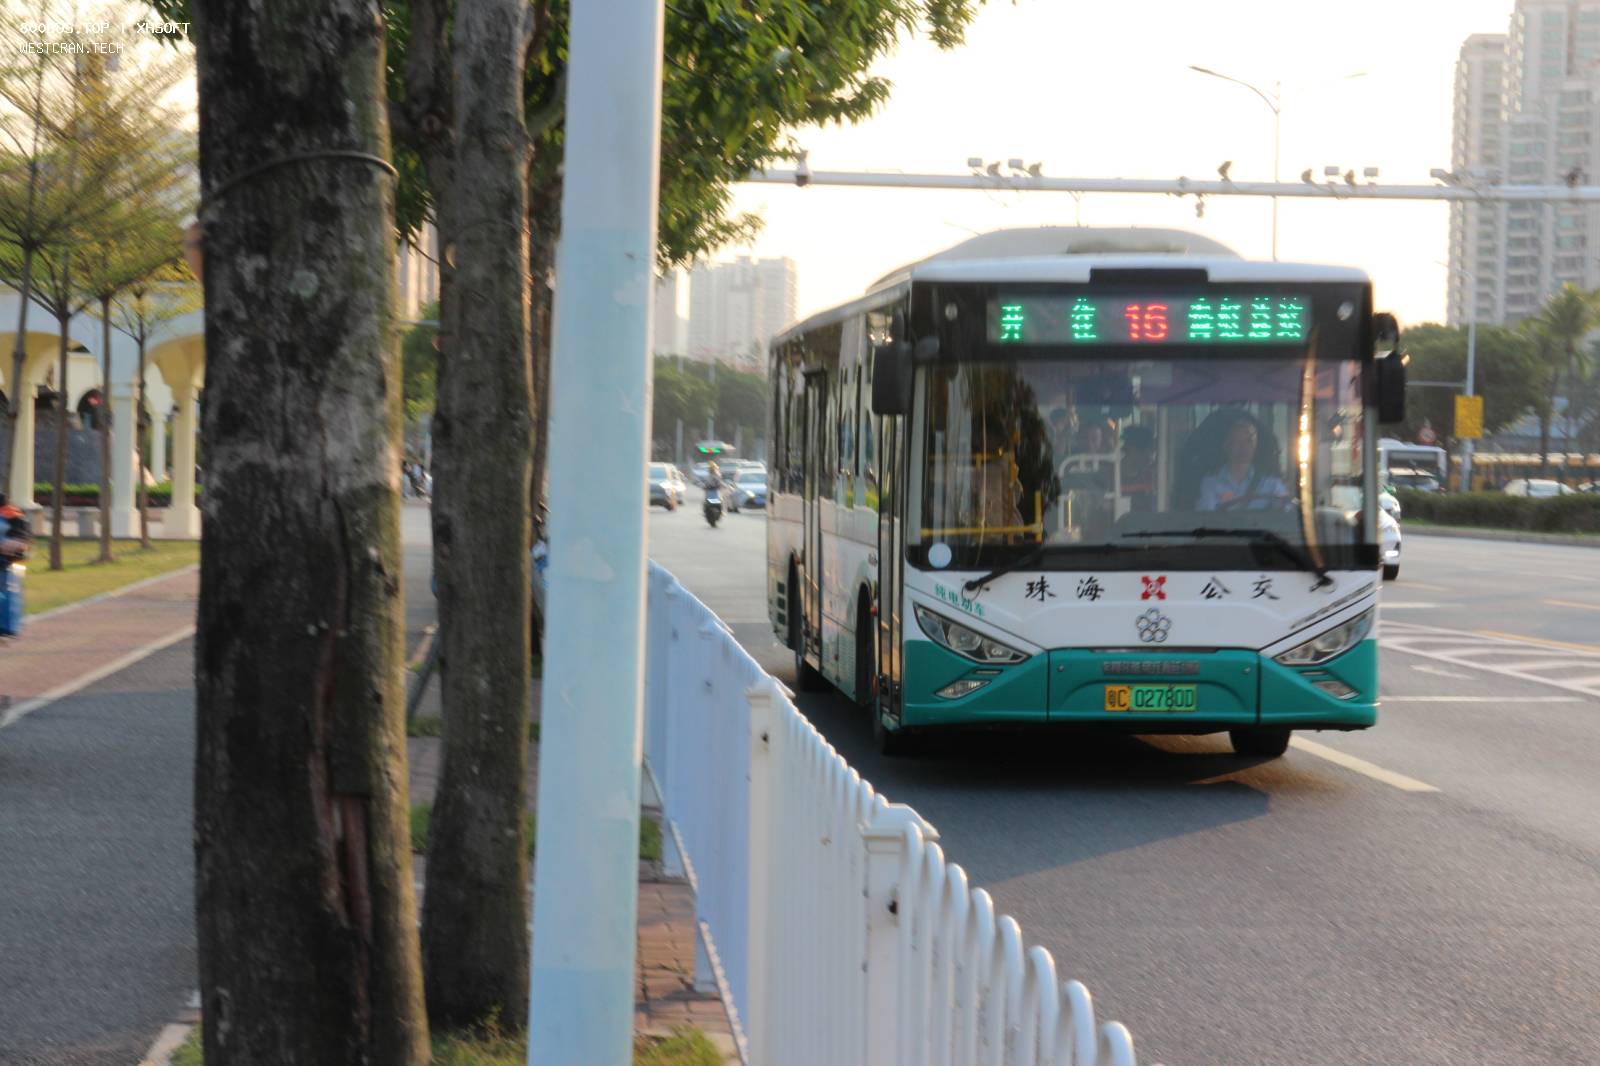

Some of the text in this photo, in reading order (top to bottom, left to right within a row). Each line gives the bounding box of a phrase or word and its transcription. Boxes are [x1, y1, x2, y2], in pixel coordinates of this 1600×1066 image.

[1125, 302, 1168, 339] 16
[1024, 574, 1280, 601] 珠海 公交
